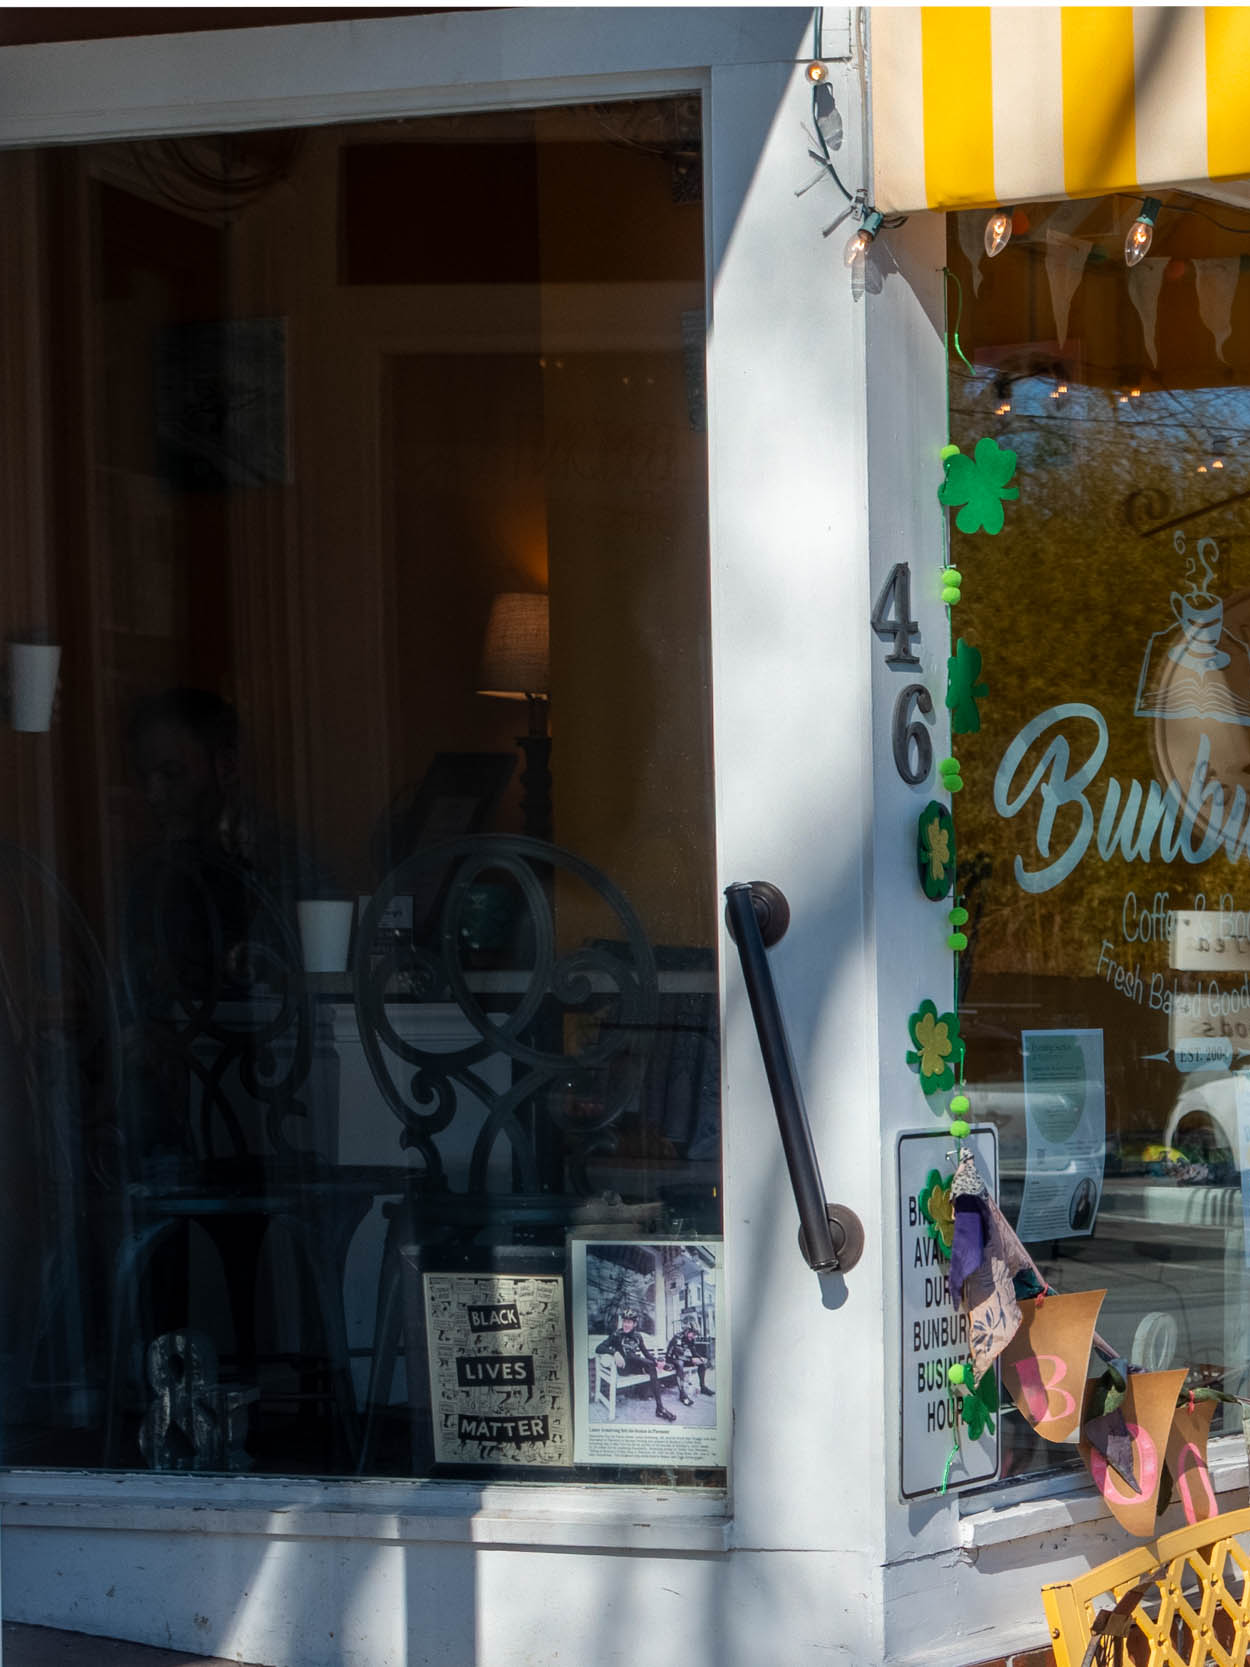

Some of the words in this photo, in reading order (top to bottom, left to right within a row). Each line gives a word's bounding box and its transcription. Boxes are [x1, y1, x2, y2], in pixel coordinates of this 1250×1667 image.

[1122, 890, 1181, 943] Coffe
[1096, 938, 1144, 1005] Fresh
[471, 1308, 519, 1327] BLACK
[464, 1361, 528, 1381] LIVES
[461, 1417, 545, 1437] MATTER
[927, 1396, 965, 1432] HOUR
